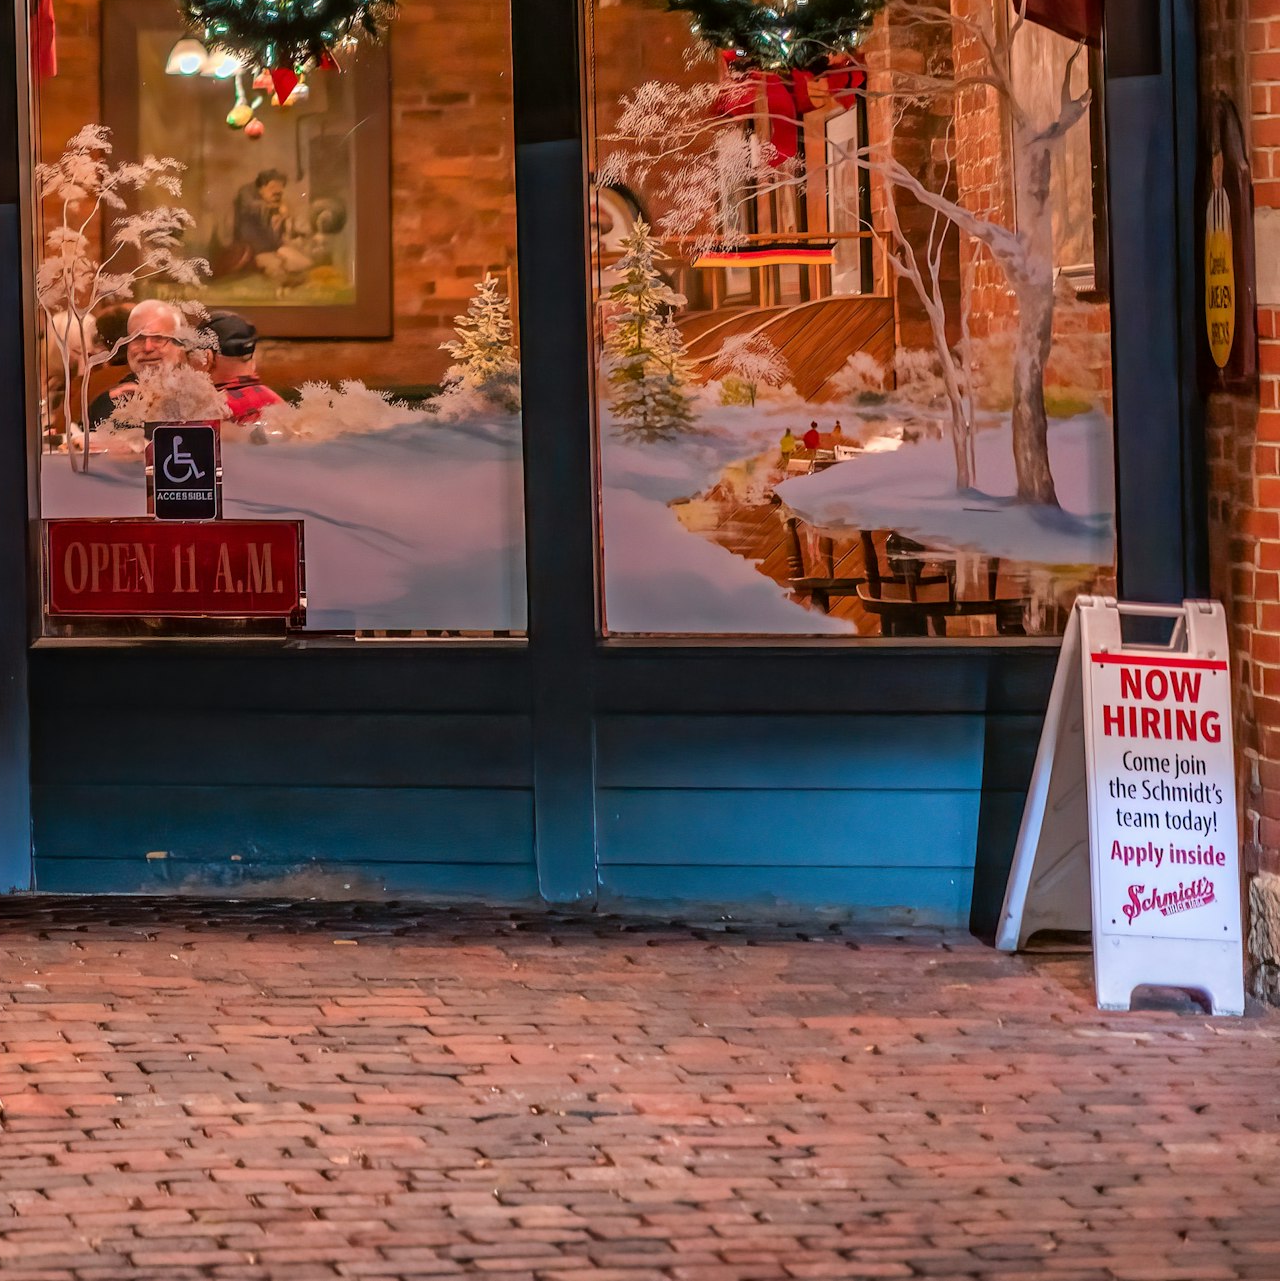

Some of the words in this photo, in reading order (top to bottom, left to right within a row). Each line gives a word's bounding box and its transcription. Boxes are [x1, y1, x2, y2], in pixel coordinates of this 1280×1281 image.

[157, 492, 213, 501] ACCESSIBLE
[63, 542, 155, 594] OPEN
[172, 543, 199, 593] 11
[213, 543, 284, 594] A.M.
[1120, 668, 1202, 704] NOW
[1103, 705, 1221, 743] HIRING
[1122, 751, 1170, 774] Come
[1175, 752, 1206, 779] join
[1109, 779, 1137, 799] the
[1142, 780, 1223, 804] Schmidt's
[1116, 809, 1160, 830] team
[1165, 810, 1217, 837] today!
[1111, 840, 1164, 868] Apply
[1169, 843, 1226, 867] inside
[1122, 876, 1214, 926] Schmidt's
